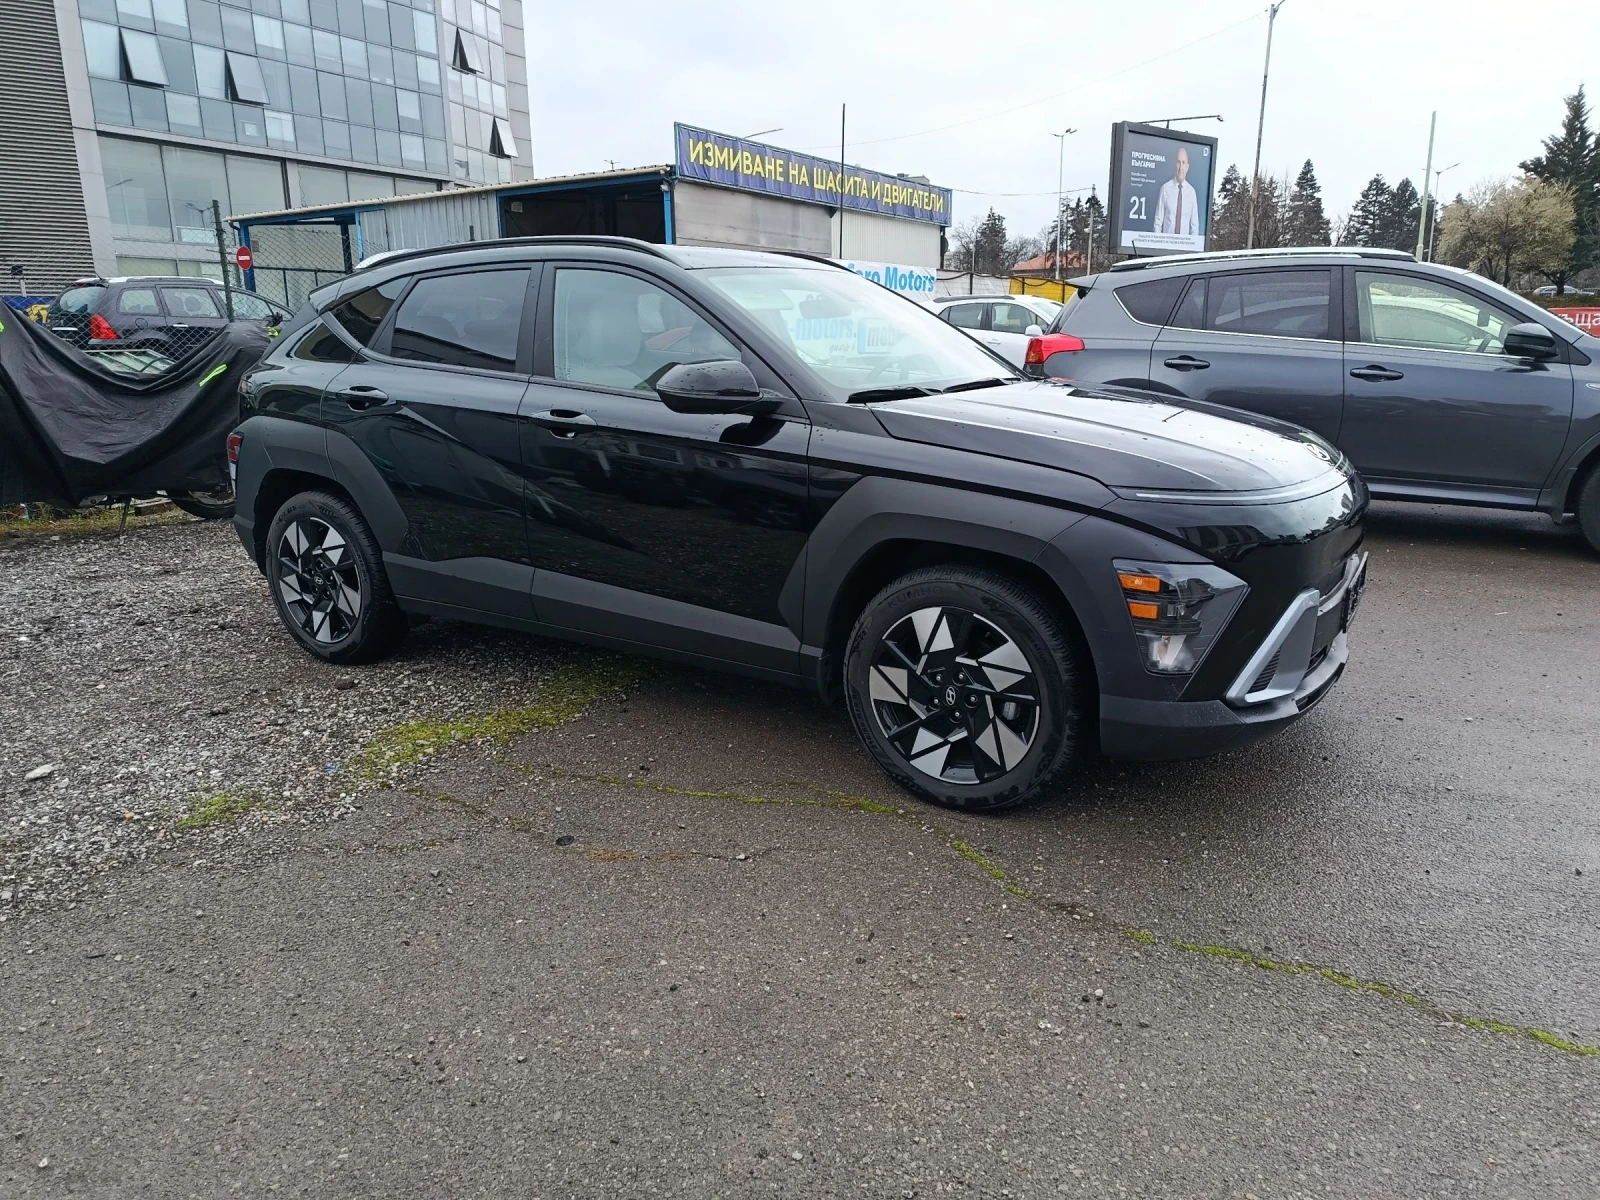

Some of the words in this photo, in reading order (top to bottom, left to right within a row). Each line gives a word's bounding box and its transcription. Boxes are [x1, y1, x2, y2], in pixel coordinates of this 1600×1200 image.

[689, 138, 784, 182] ИЗМИВАНЕ
[789, 164, 809, 187] НА
[813, 167, 868, 198] ШАСИТА
[871, 180, 880, 201] И
[882, 182, 943, 213] ДВИГАТЕЛИ
[1129, 196, 1147, 220] 21
[884, 266, 936, 293] Motors
